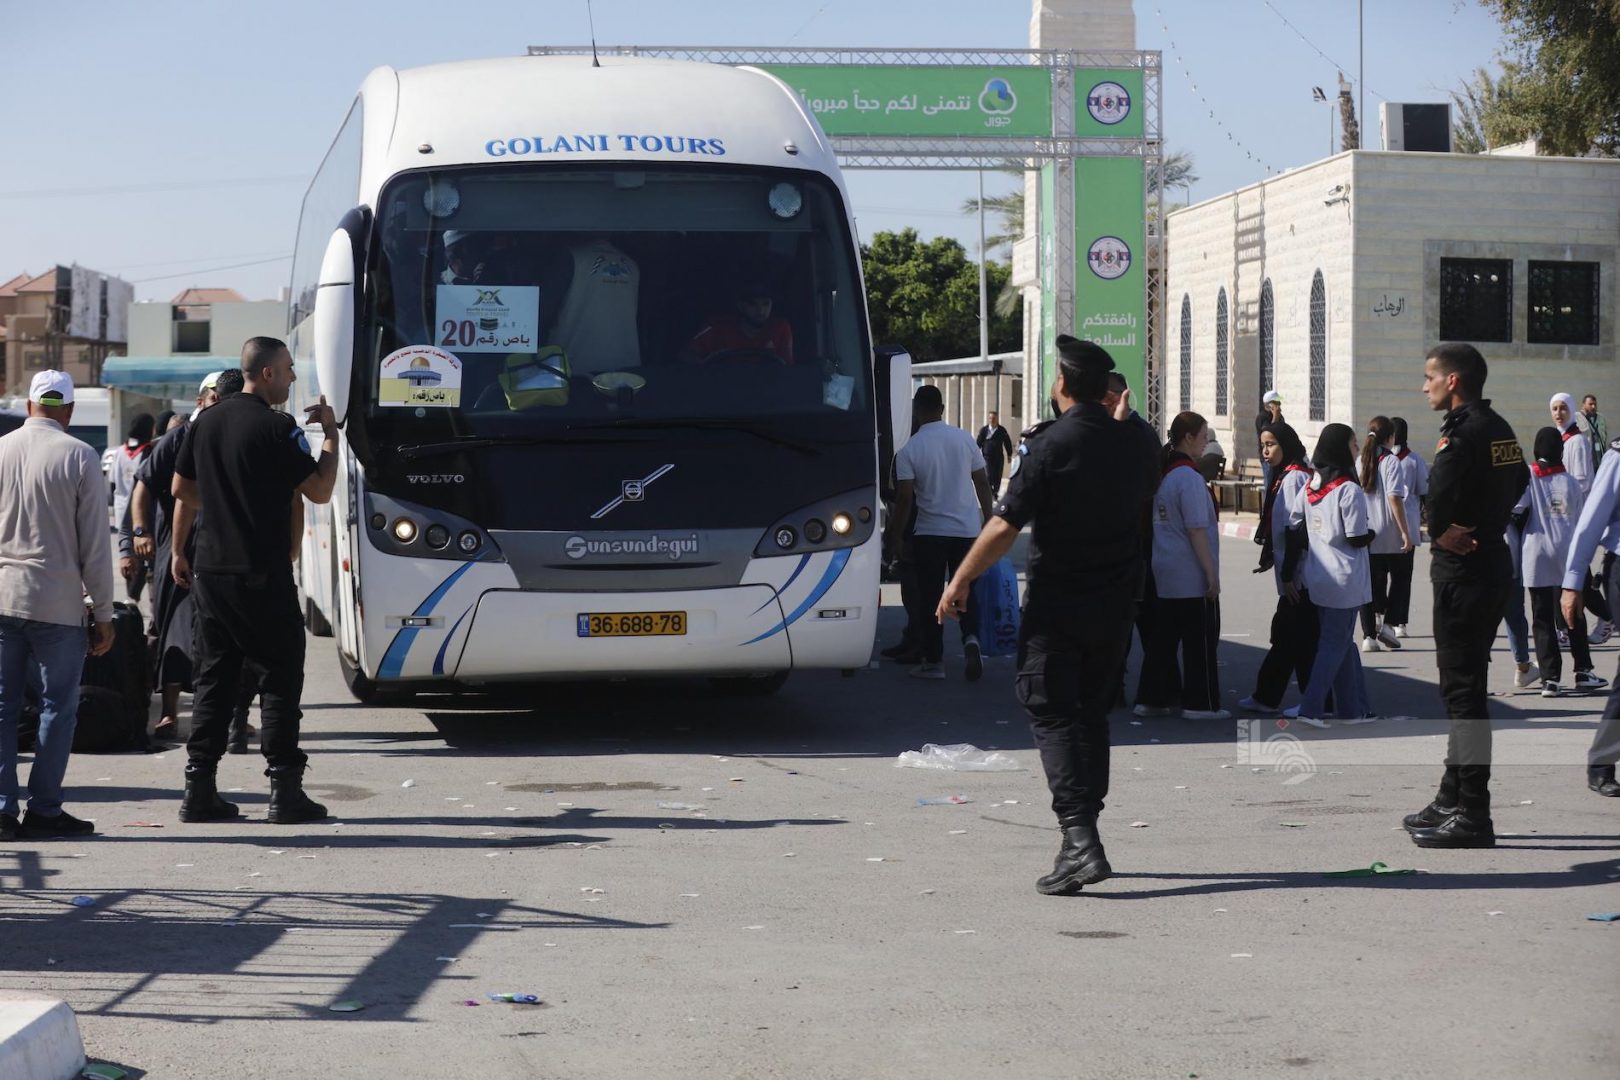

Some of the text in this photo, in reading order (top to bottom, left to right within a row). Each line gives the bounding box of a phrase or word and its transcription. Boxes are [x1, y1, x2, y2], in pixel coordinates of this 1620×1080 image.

[885, 94, 917, 115] لكم
[922, 95, 971, 115] نتمنى
[984, 116, 1011, 128] جوال
[485, 135, 725, 156] GOLANI TOURS
[441, 319, 530, 347] باص رقم 20
[1491, 443, 1522, 464] POLICE
[406, 474, 465, 484] VOLVO
[565, 534, 698, 559] Sunsundegui
